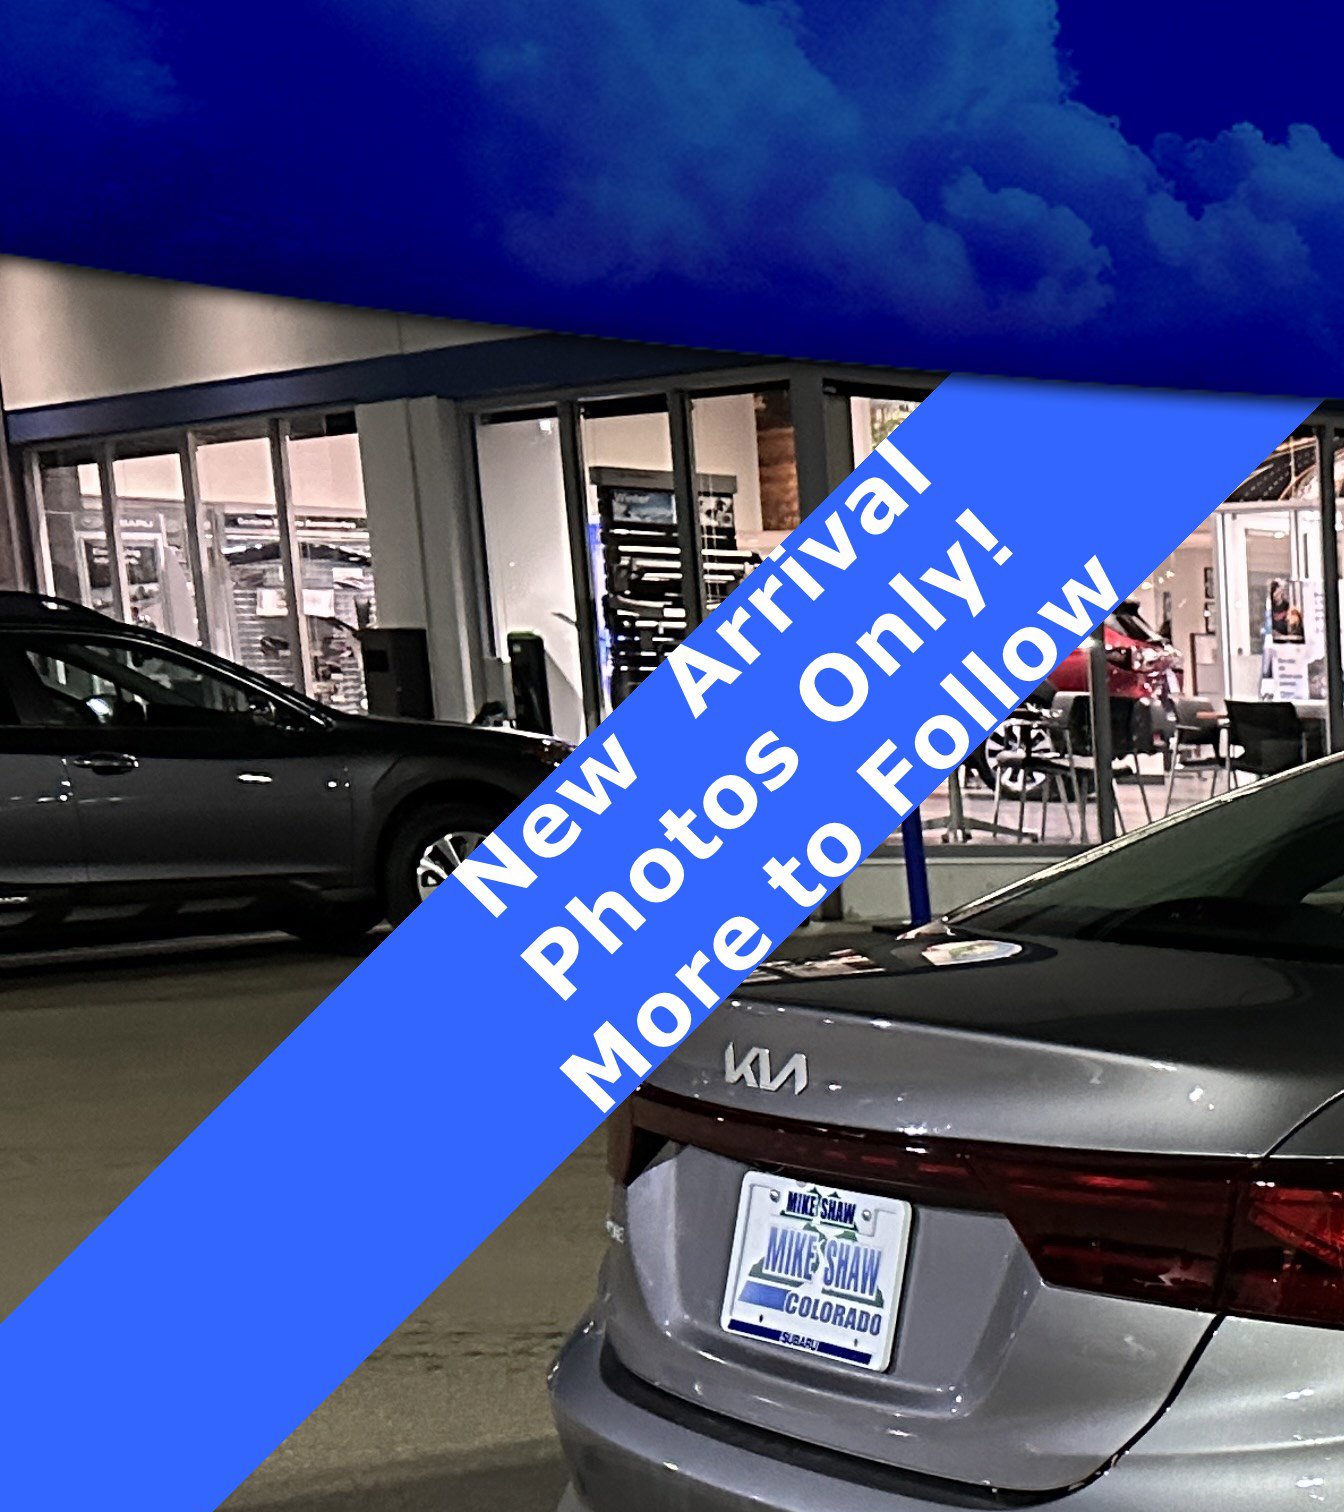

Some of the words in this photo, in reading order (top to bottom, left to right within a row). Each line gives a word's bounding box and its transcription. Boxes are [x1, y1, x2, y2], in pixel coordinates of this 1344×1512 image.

[724, 1040, 808, 1096] KIA
[786, 1190, 818, 1218] MIKE
[820, 1197, 857, 1225] SHAW
[763, 1226, 819, 1282] MIKE
[822, 1239, 882, 1297] SHAW
[784, 1292, 883, 1337] COLORADO
[780, 1330, 820, 1351] SUBARU
